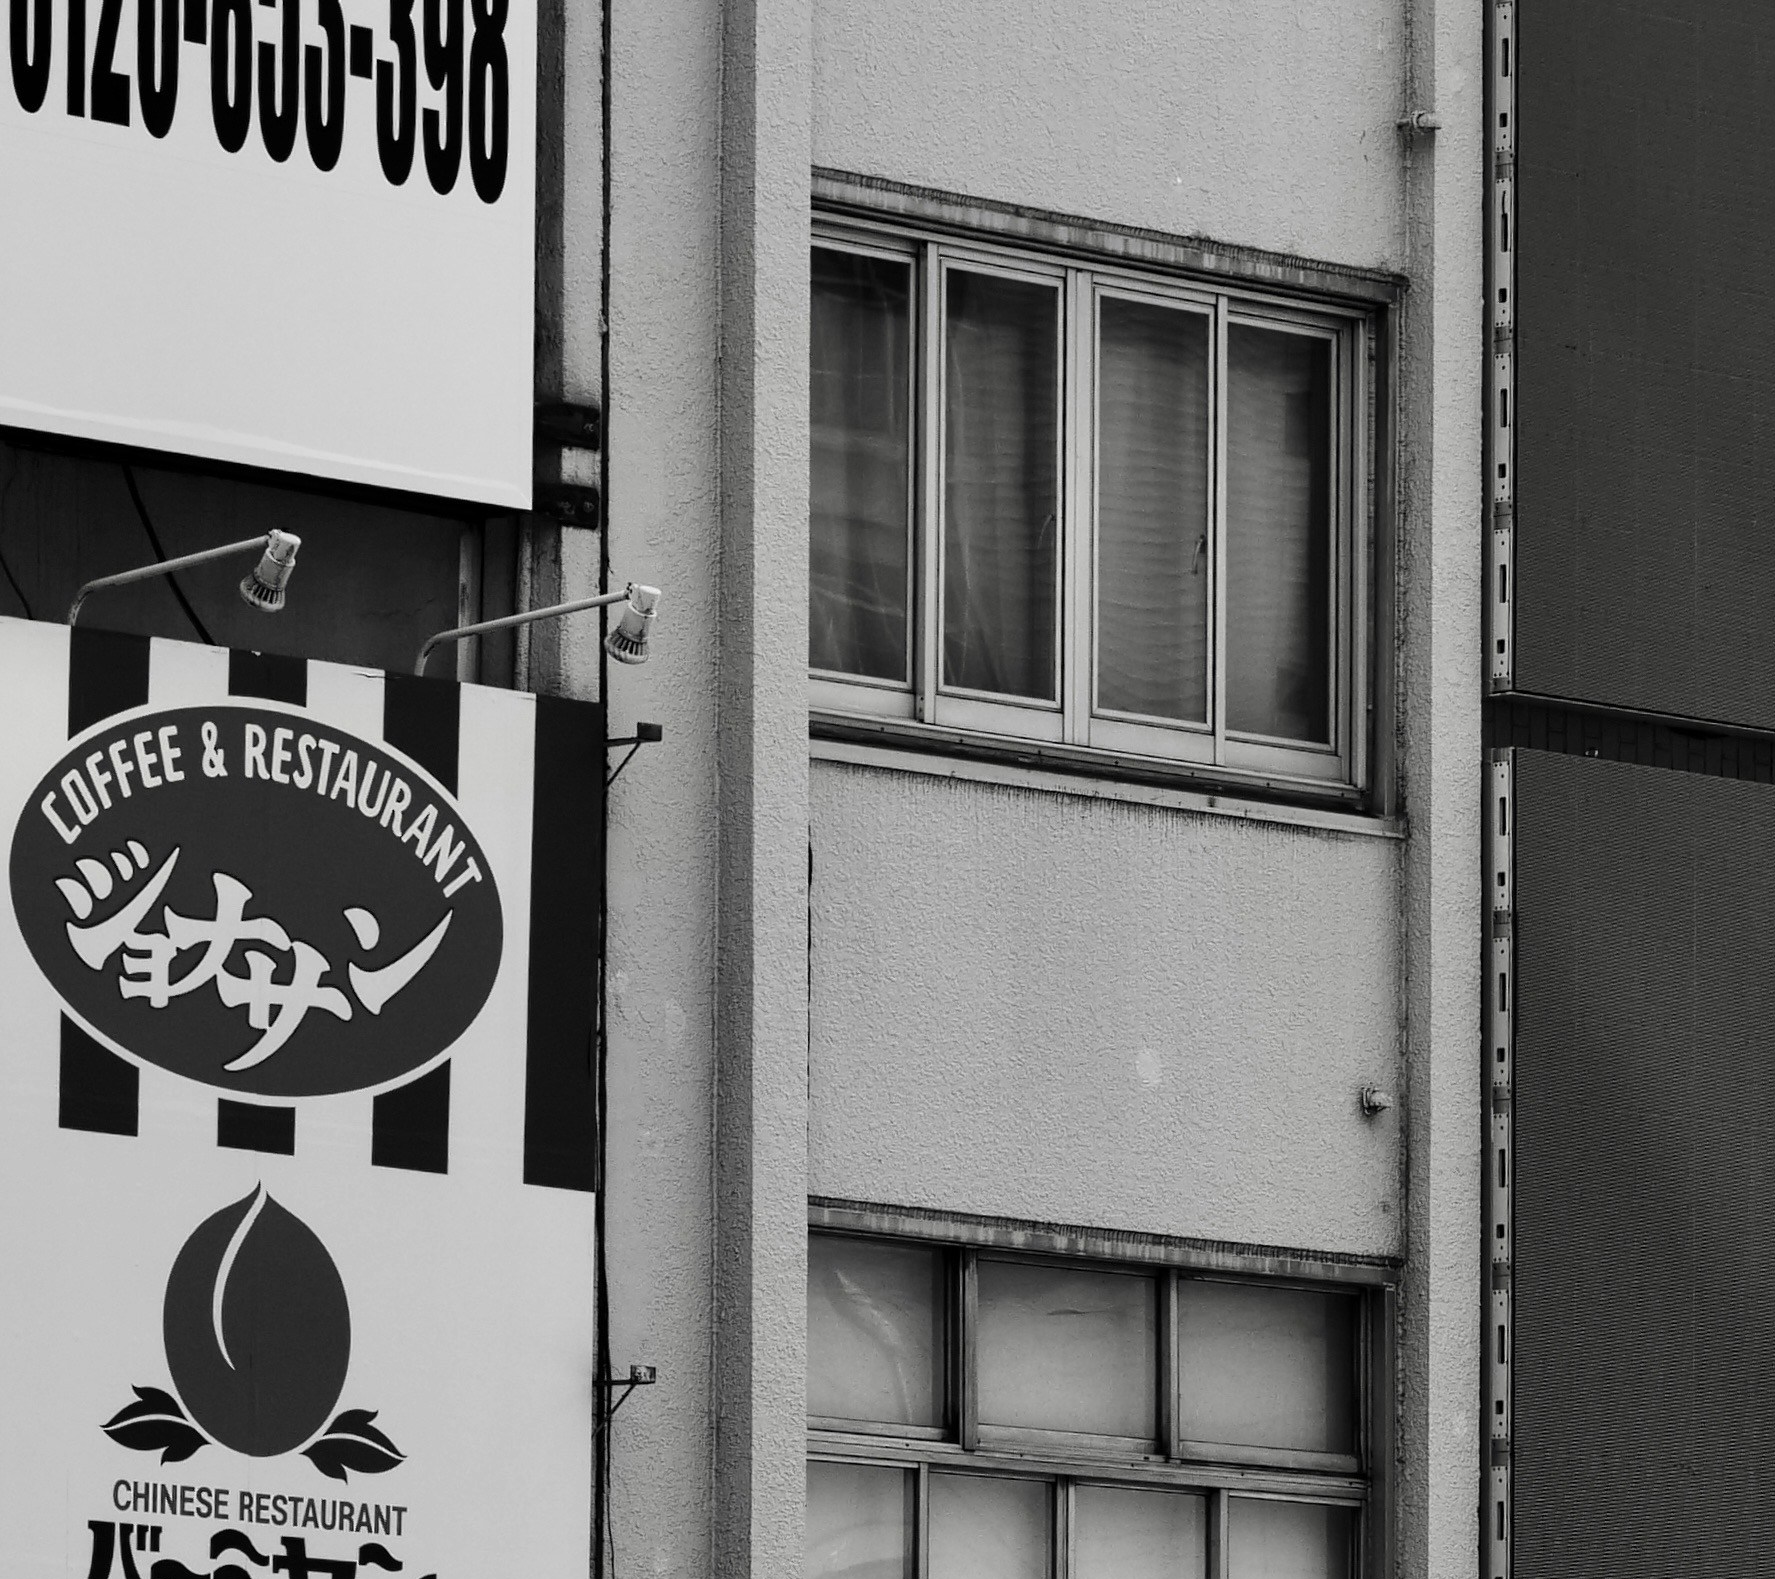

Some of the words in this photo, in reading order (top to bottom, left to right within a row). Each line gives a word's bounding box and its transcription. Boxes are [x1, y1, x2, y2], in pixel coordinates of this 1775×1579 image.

[41, 723, 184, 845] COFFEE
[202, 721, 227, 777] &
[244, 722, 483, 899] RESTAURANT
[53, 839, 454, 1072] ジョナサン
[112, 1479, 230, 1519] CHINESE
[239, 1490, 408, 1537] RESTAURANT
